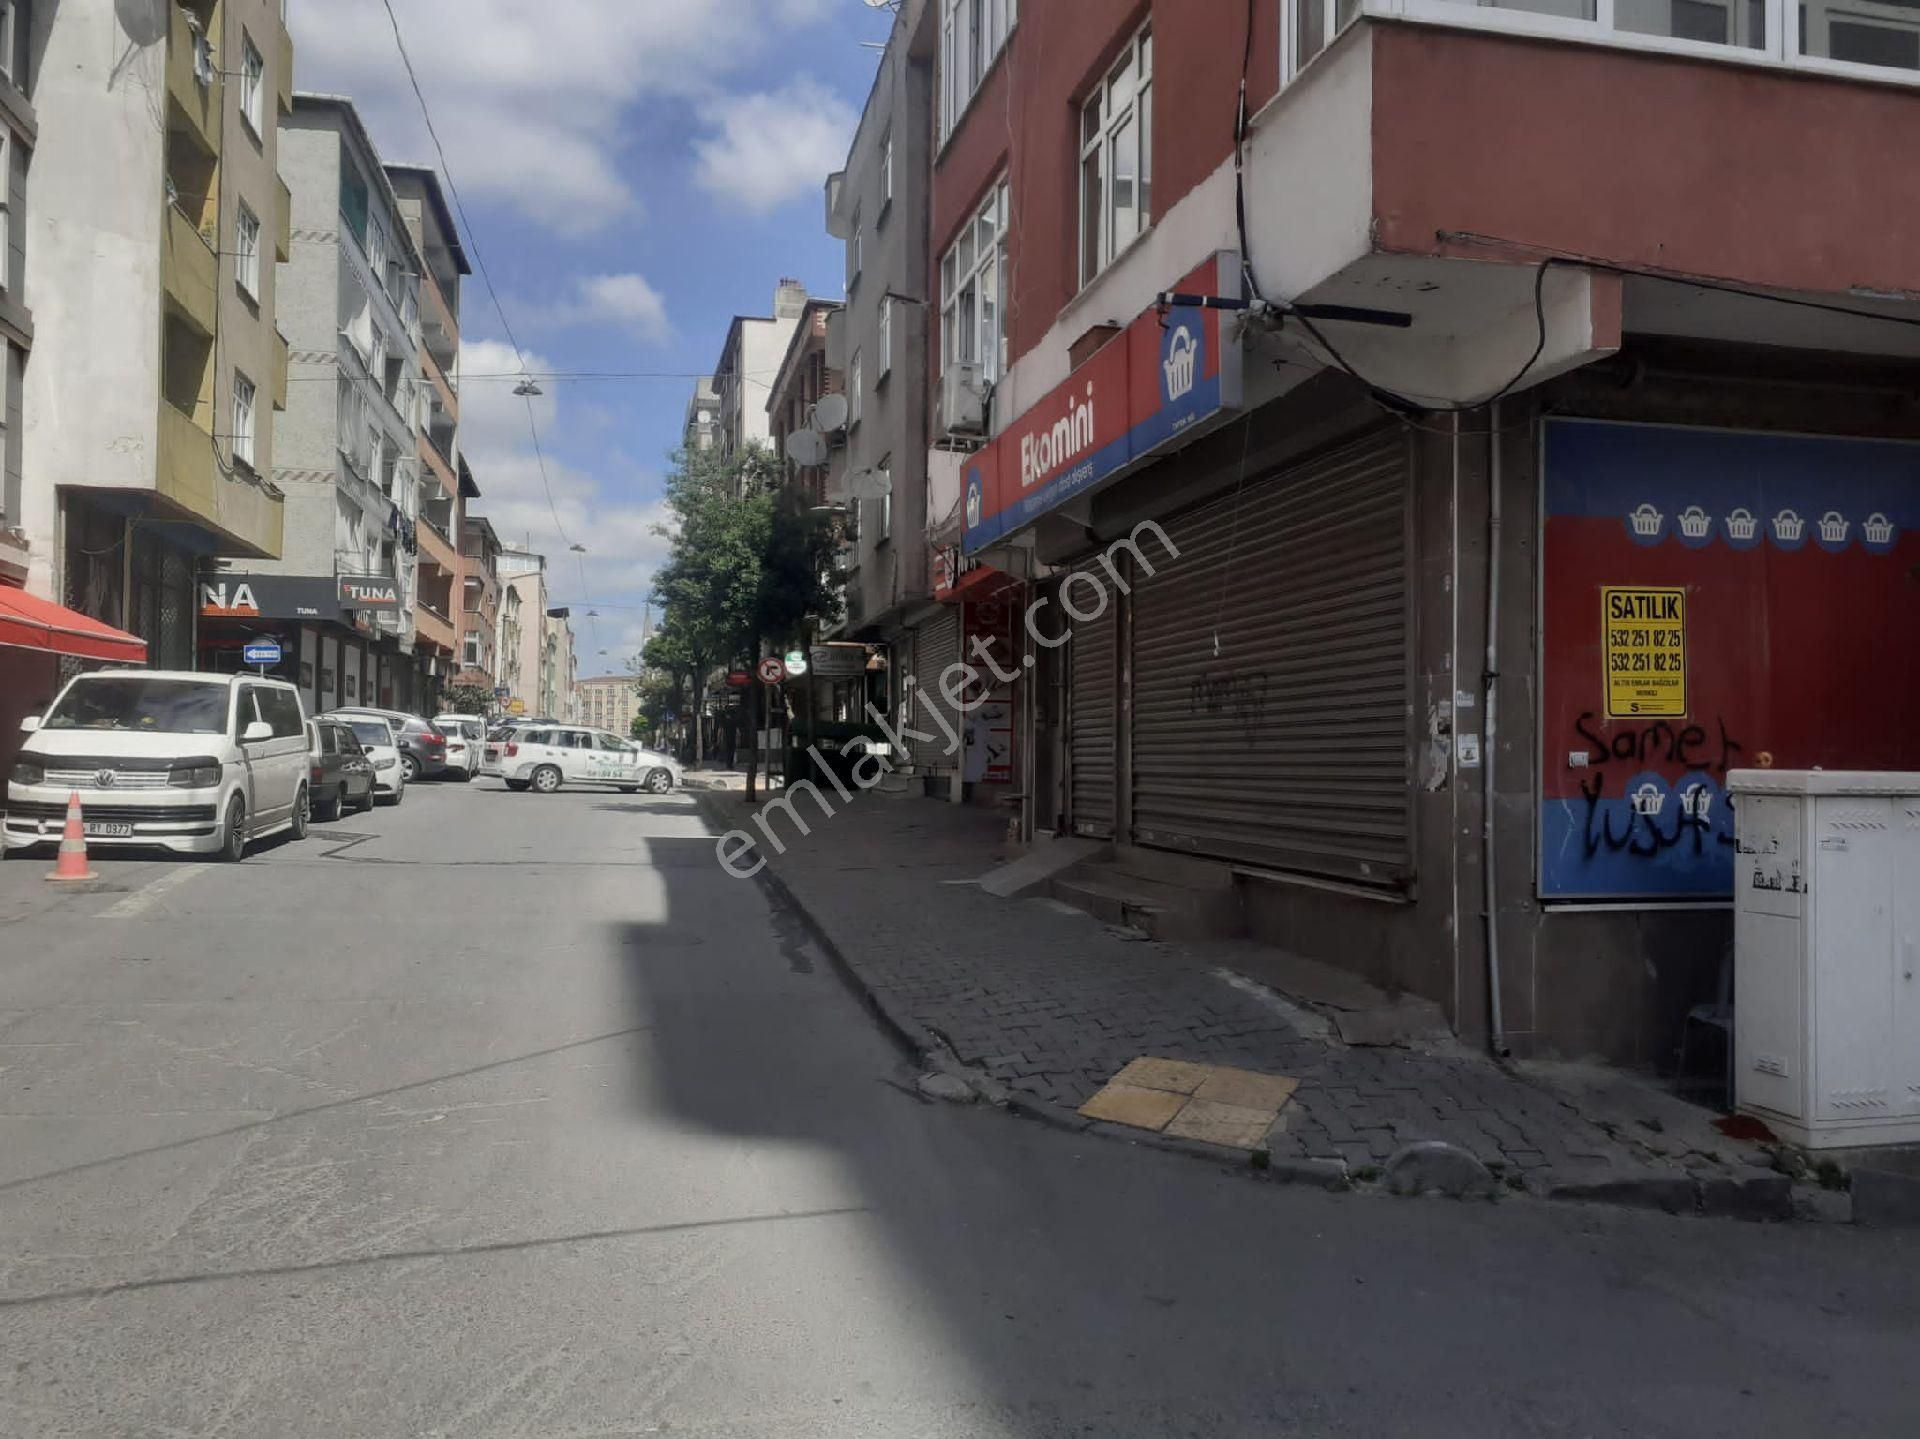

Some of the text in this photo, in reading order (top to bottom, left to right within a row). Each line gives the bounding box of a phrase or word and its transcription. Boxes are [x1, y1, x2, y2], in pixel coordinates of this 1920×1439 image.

[1021, 381, 1094, 488] Ekomini
[350, 586, 397, 601] TUNA
[296, 607, 319, 616] TUNA
[1611, 595, 1679, 619] SATILIK
[1611, 629, 1681, 647] 532 251 82 25
[1611, 653, 1681, 671] 532 251 82 25
[106, 823, 129, 834] 0377
